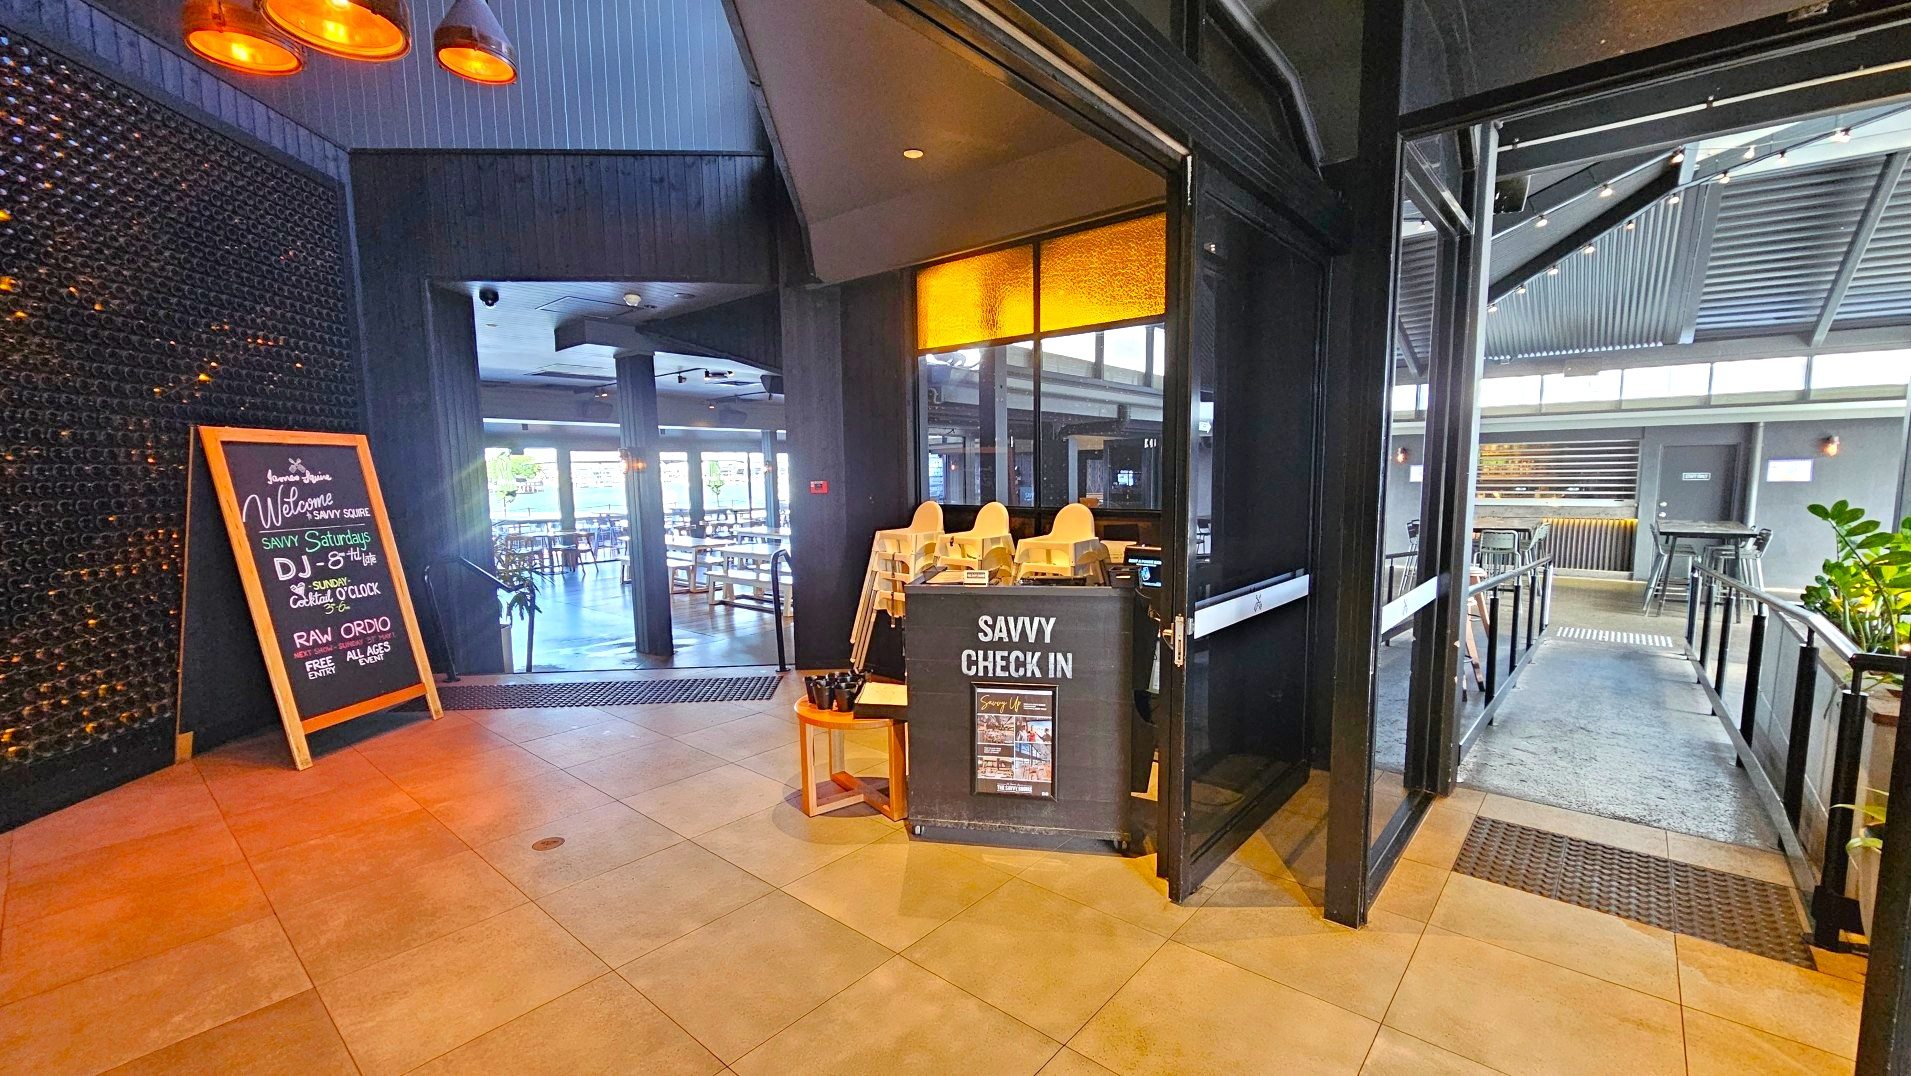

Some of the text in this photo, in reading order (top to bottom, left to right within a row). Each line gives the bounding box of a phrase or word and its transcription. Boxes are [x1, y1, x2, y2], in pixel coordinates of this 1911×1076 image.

[243, 484, 333, 528] Welcome
[313, 509, 341, 520] SAVVY
[343, 507, 371, 518] SQUIRE
[261, 530, 371, 553] SAVVY Saturdays
[273, 555, 312, 581] DJ
[362, 552, 377, 567] late
[289, 582, 381, 609] Cocktail O'CLOCK
[293, 616, 391, 649] RAW ORDIO
[977, 615, 1057, 643] SAVVY
[293, 649, 312, 659] NEXT
[314, 645, 333, 655] SHOW
[346, 641, 391, 662] ALL AGES
[358, 653, 384, 666] EVENT
[305, 656, 335, 672] FREE
[308, 666, 336, 680] ENTRY
[961, 649, 1073, 679] CHECK IN
